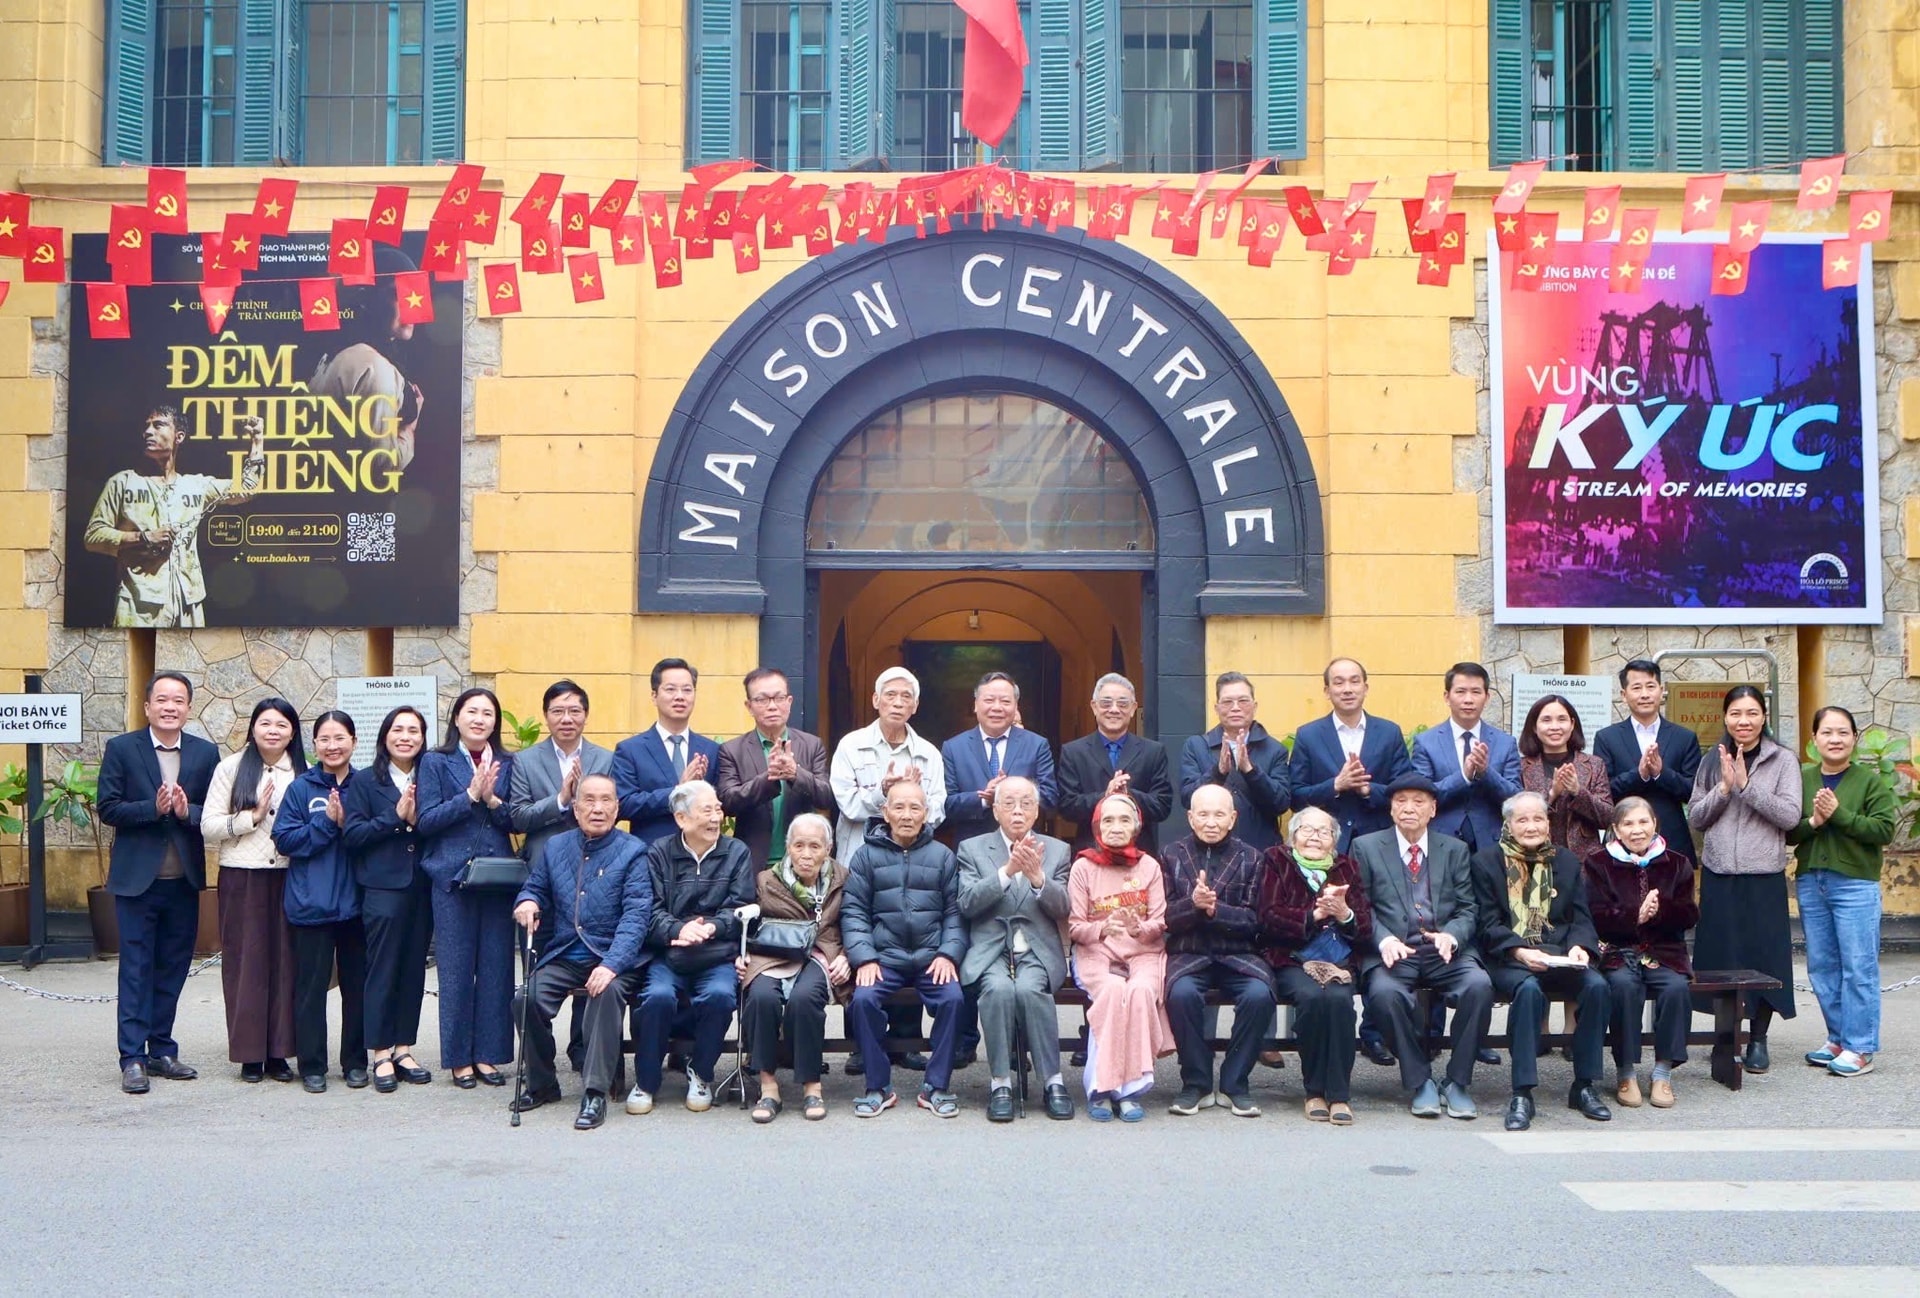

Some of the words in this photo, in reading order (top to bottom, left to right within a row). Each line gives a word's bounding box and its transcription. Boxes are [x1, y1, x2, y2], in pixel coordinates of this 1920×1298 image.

[182, 243, 193, 253] SỞ
[280, 243, 307, 251] THÀNH
[308, 241, 326, 251] PHỐ
[259, 254, 278, 262] TÍCH
[279, 253, 297, 262] NHÀ
[297, 253, 308, 262] TÙ
[1573, 264, 1599, 279] BÀY
[1541, 281, 1577, 292] IBITION
[236, 301, 268, 310] TRÌNH
[238, 311, 263, 320] TRẢI
[166, 330, 298, 388] ĐÊM
[1526, 358, 1640, 396] VÙNG
[678, 281, 899, 550] MAISON
[961, 252, 1275, 548] CENTRALE
[182, 381, 403, 440] THIÊNG
[1527, 395, 1688, 469] KÝ
[1699, 396, 1839, 471] ỨC
[227, 437, 404, 494] LIÊNG
[1562, 481, 1651, 497] STREAM
[1659, 482, 1689, 497] OF
[1694, 482, 1807, 498] MEMORIES
[249, 525, 284, 536] 19:00
[303, 524, 338, 536] 21:00
[247, 553, 310, 563] tour.hoalo.vn
[1542, 678, 1568, 686] THÔNG
[21, 705, 48, 717] BÁN
[51, 705, 67, 717] VÉ
[0, 720, 29, 730] icket
[33, 720, 67, 730] Office
